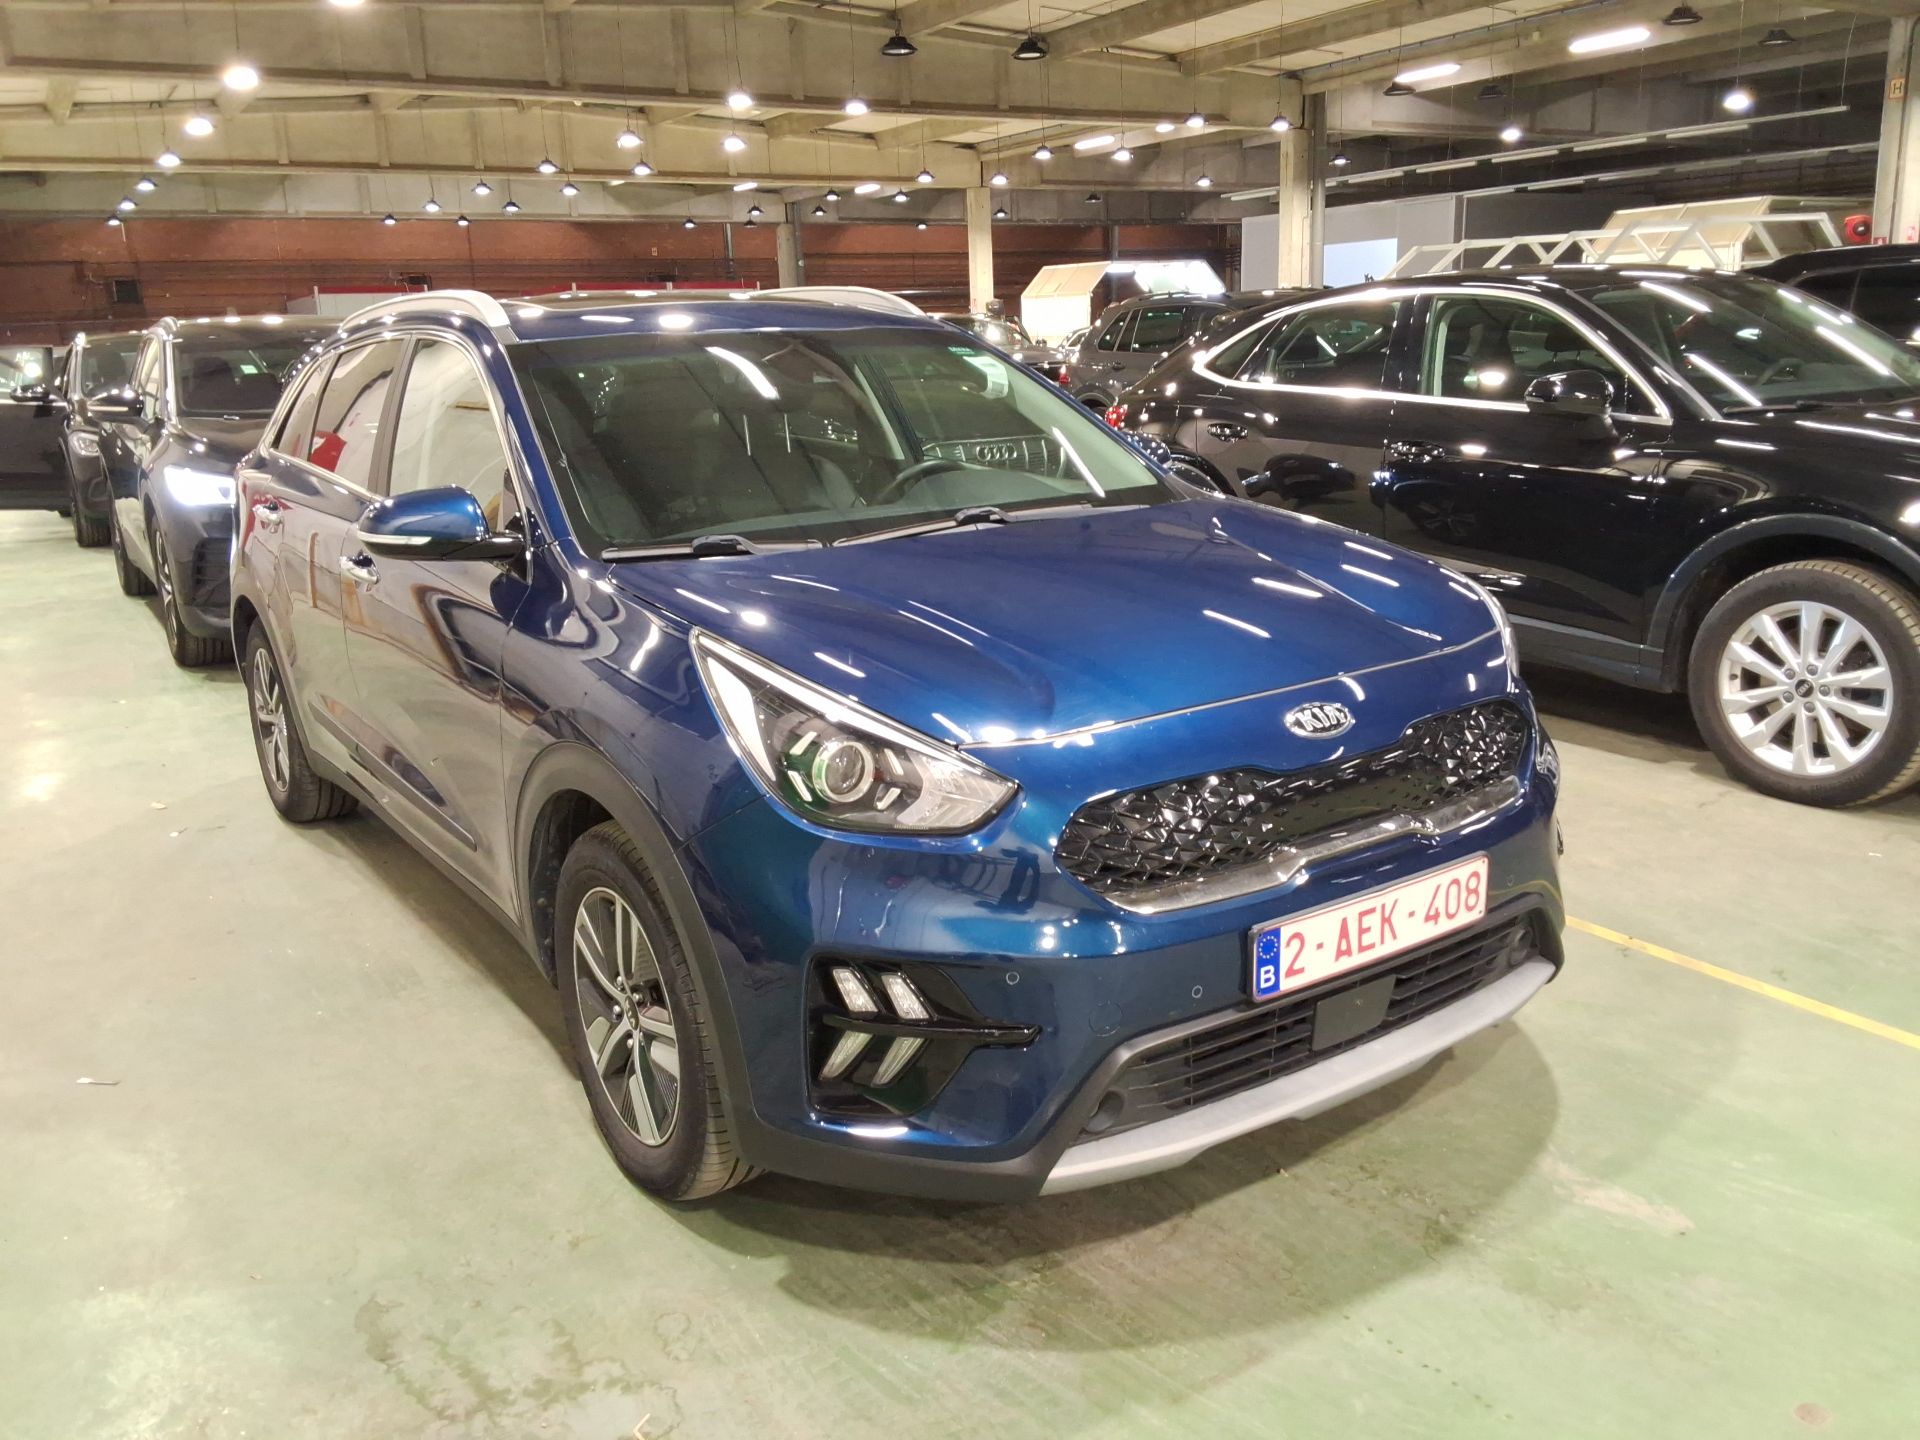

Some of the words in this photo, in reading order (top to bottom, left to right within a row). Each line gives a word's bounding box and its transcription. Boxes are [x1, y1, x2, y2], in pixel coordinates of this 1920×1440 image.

[1294, 705, 1347, 732] KIA
[1284, 870, 1481, 979] 2-AEK-408
[1260, 964, 1276, 989] B
